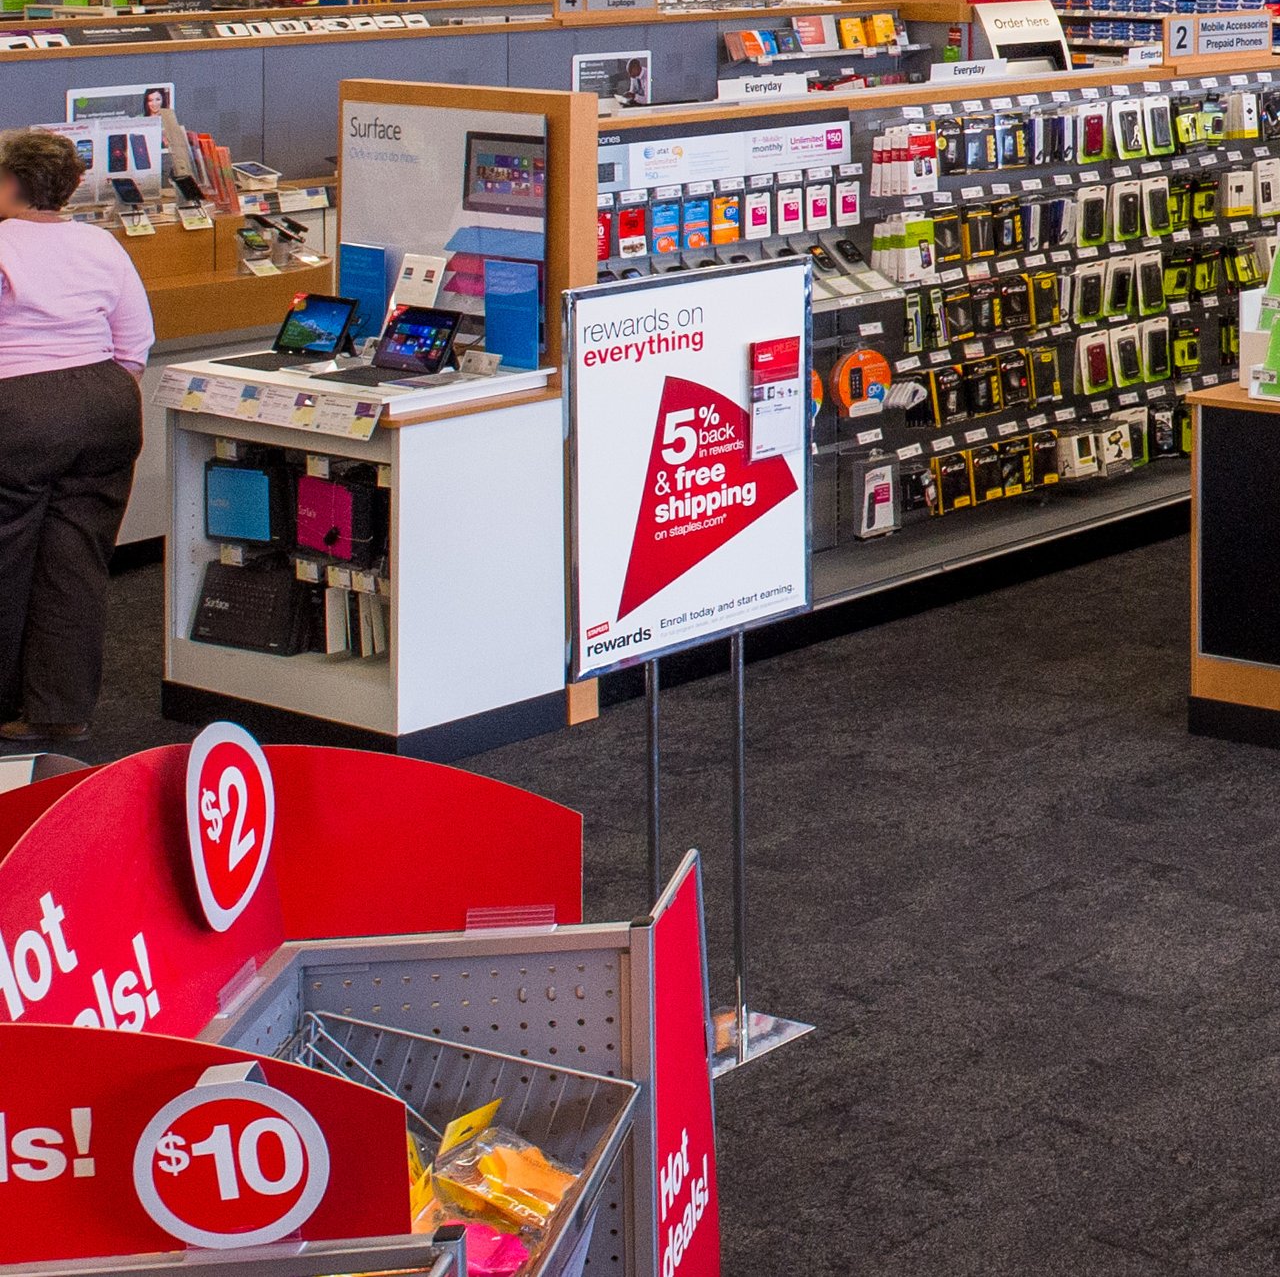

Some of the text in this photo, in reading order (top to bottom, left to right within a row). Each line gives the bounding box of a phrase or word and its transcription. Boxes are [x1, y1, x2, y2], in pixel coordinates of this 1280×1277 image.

[994, 17, 1050, 30] Order here
[1200, 17, 1269, 34] Mobile Accessories
[1175, 26, 1188, 50] 2
[1205, 36, 1263, 50] Prepaid Phones
[953, 64, 985, 76] Everyday
[745, 81, 782, 94] Everyday
[350, 116, 402, 141] Surface
[789, 133, 824, 146] Unlimited
[826, 132, 842, 142] $50
[752, 143, 783, 154] monthly
[583, 306, 704, 344] rewards on
[584, 329, 704, 368] everything
[867, 383, 881, 397] go
[699, 423, 735, 445] back
[699, 438, 744, 458] in rewards
[655, 463, 726, 496] & free
[655, 480, 757, 524] shipping
[655, 515, 727, 541] on staples.com
[204, 597, 230, 610] Surface
[660, 584, 795, 630] Enroll today and start earning.
[587, 625, 652, 658] rewards
[200, 765, 256, 873] $2
[156, 1116, 307, 1202] $10
[660, 1127, 690, 1223] Hot
[662, 1153, 710, 1277] deals!
